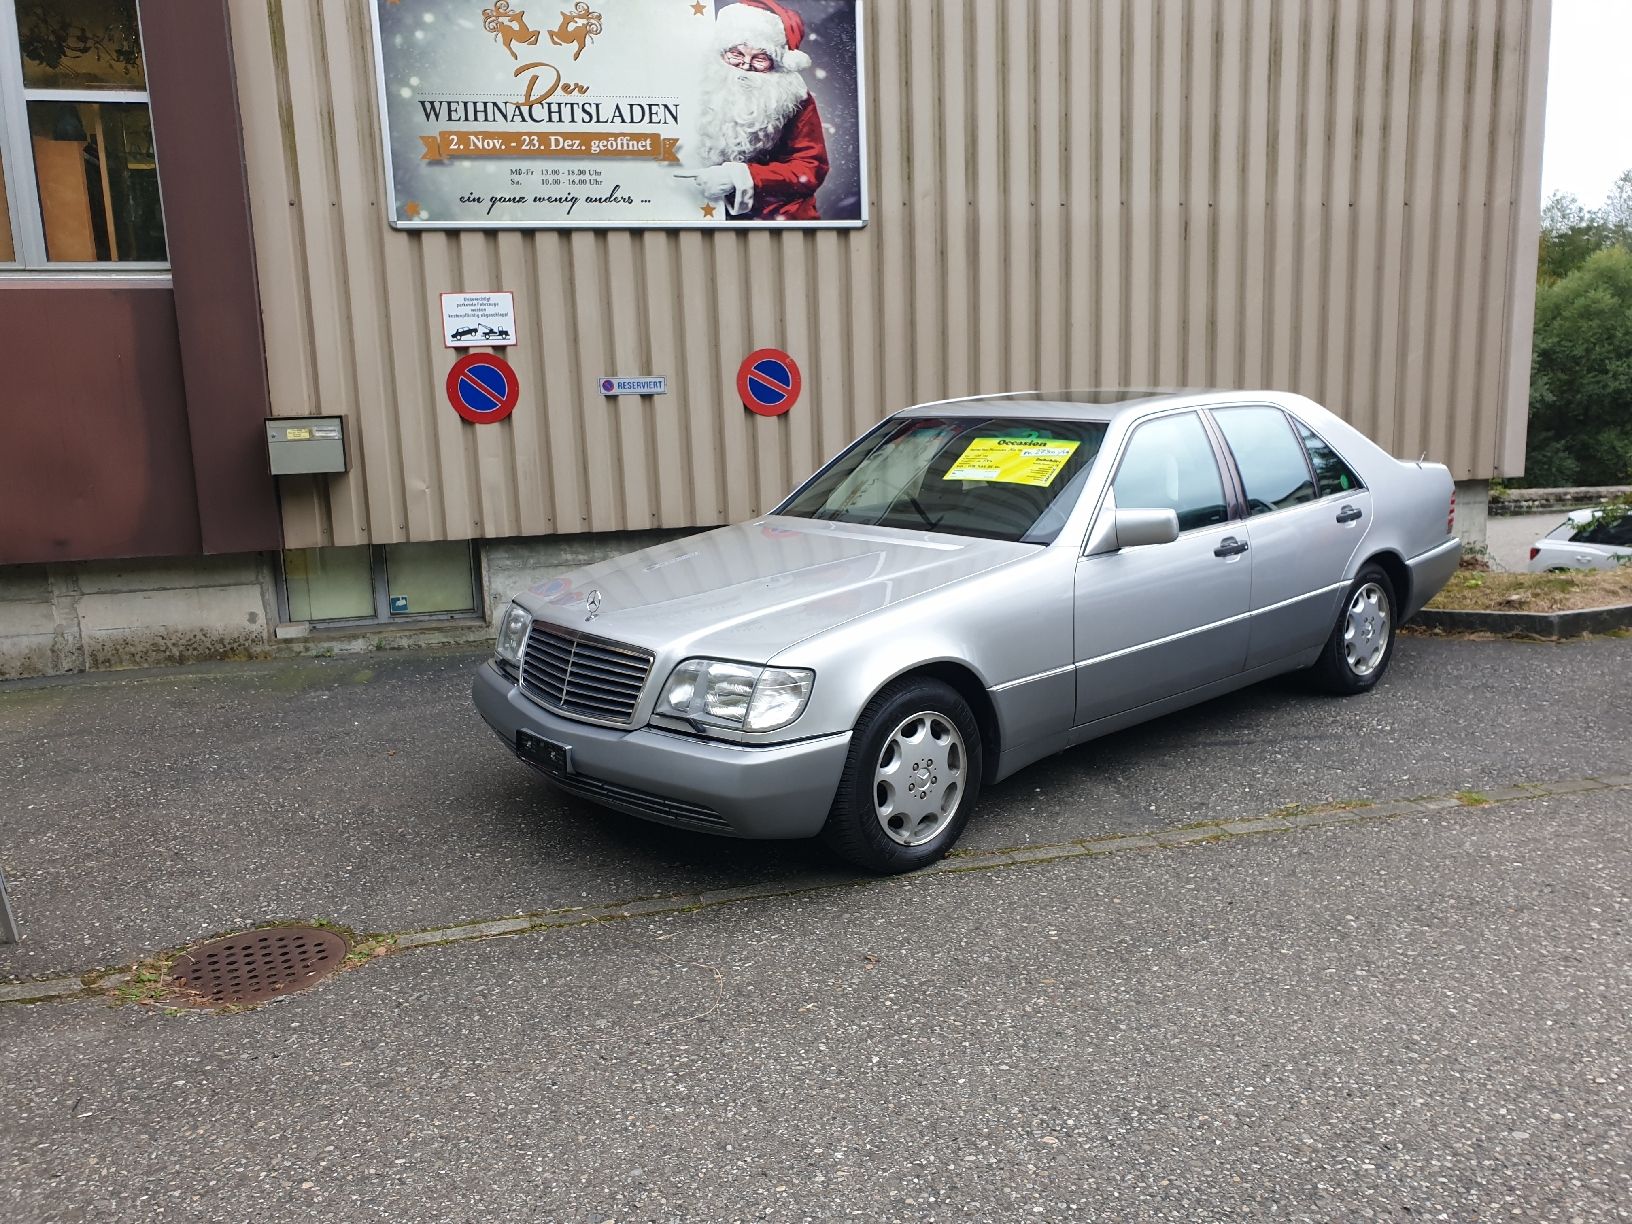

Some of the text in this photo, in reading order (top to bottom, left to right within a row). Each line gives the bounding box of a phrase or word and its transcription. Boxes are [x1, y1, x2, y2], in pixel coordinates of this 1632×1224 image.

[508, 62, 590, 107] Der
[418, 100, 680, 126] WEIHNACHTSLADEN
[449, 135, 464, 150] 2.
[469, 136, 505, 151] Nov.
[521, 136, 545, 151] 23.
[550, 137, 586, 151] Dez.
[591, 137, 653, 154] geöffnet
[510, 178, 523, 186] Sa.
[568, 179, 588, 187] 16.00
[589, 179, 604, 187] Uhr
[588, 169, 602, 177] Uhr
[459, 194, 485, 205] ein
[487, 193, 529, 216] ganz
[533, 191, 581, 216] wenig
[585, 184, 634, 206] anders
[617, 381, 663, 389] RESERVIERT
